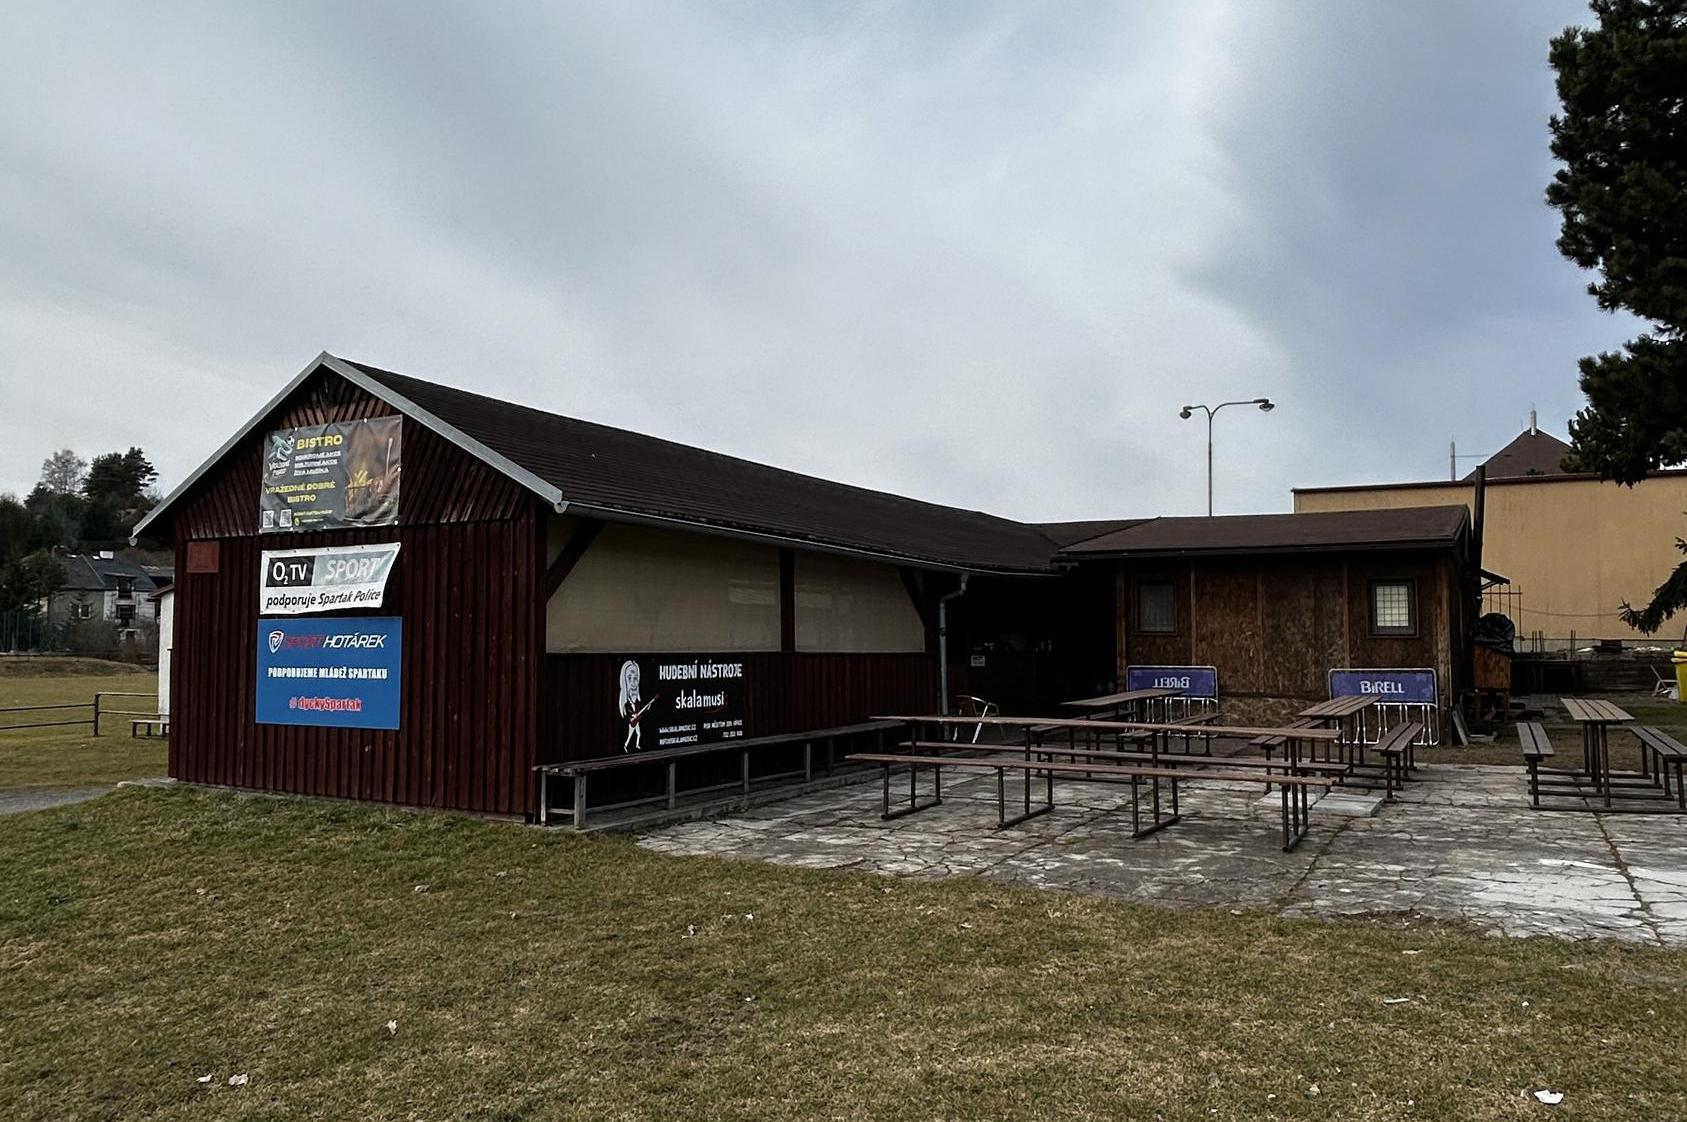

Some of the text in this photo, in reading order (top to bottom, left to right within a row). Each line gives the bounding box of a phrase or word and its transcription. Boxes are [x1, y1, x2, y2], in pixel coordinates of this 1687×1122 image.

[296, 435, 343, 450] BISTRO
[265, 480, 336, 494] VRAŽEDNÉ DOBRÉ
[287, 494, 317, 503] BISTRO
[290, 563, 307, 581] TV
[325, 558, 385, 581] SPORT
[266, 589, 381, 609] podporuje Spartak Police
[322, 632, 388, 649] HOTÁREK
[268, 666, 388, 679] PODPORUJEME MLÁDEŽ SPARTAKU
[659, 659, 743, 680] HUDEBNÍ NÁSTROJE
[675, 689, 728, 710] skalamusi
